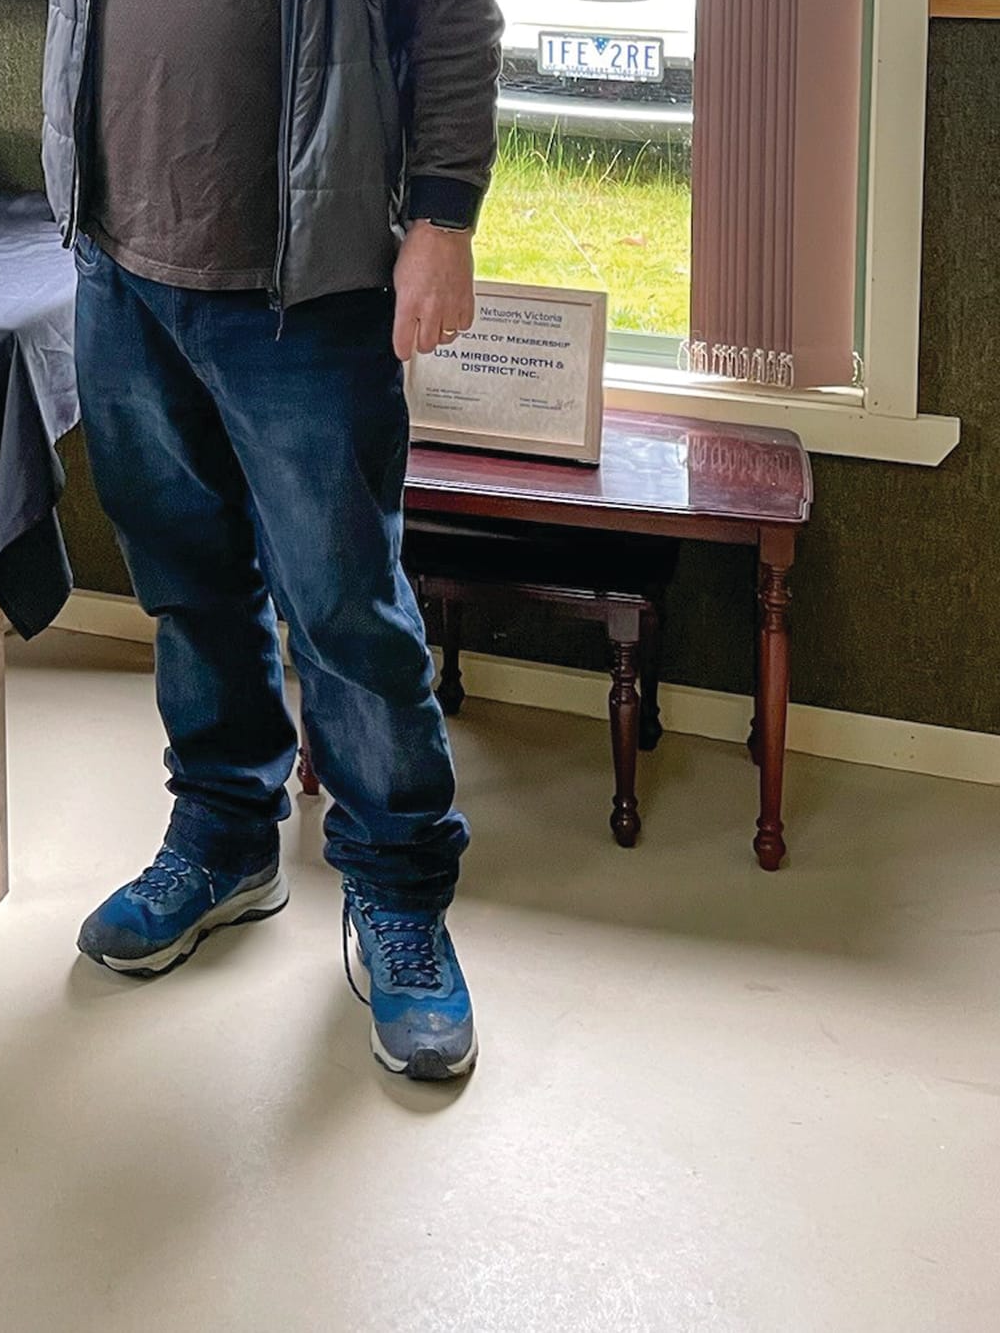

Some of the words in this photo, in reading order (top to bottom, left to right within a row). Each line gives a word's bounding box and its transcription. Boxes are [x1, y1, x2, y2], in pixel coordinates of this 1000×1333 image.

[611, 44, 656, 70] 2RE
[480, 307, 522, 319] Network
[524, 311, 562, 322] Victoria
[434, 349, 458, 358] U3A
[461, 351, 508, 363] MIRBOO
[511, 356, 553, 369] NORTH
[461, 363, 516, 376] DISTRICT
